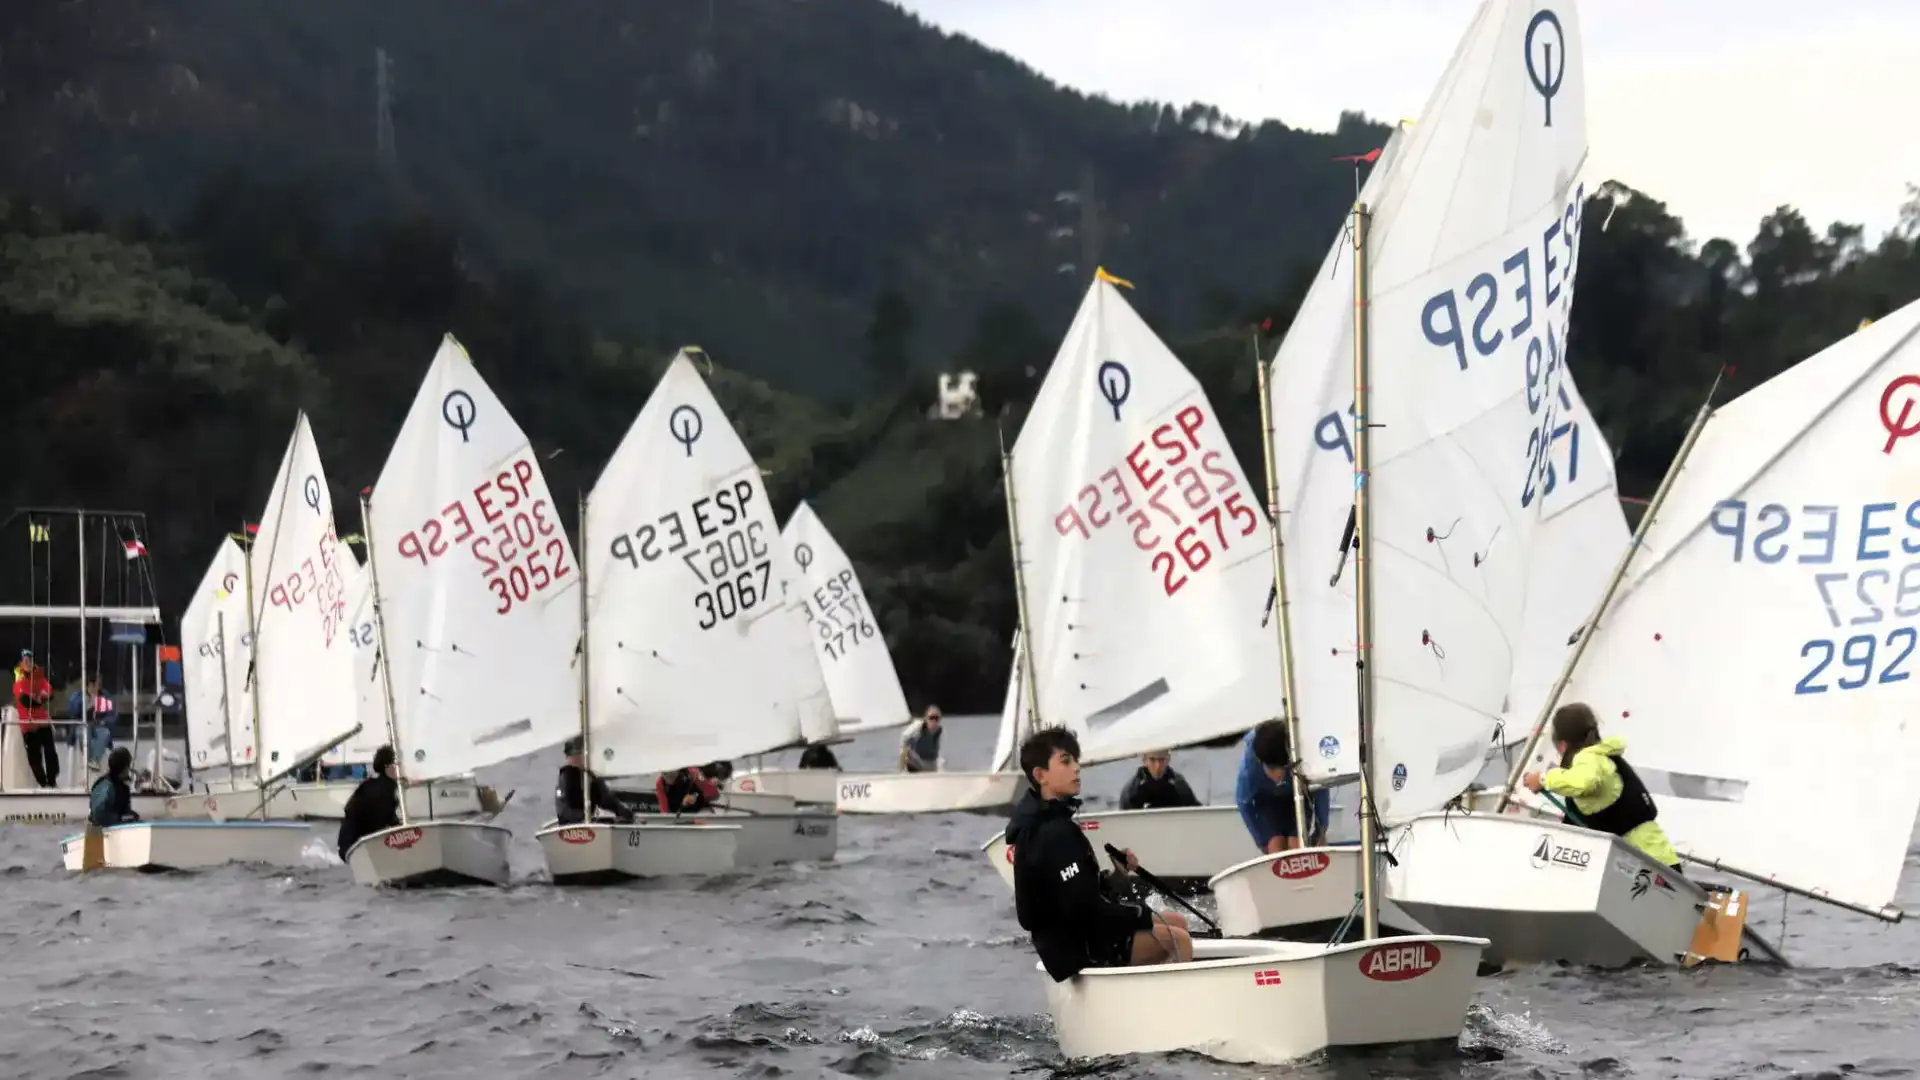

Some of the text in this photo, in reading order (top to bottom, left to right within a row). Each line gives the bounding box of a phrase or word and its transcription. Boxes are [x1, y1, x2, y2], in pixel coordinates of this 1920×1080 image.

[1126, 405, 1205, 491] ESP
[473, 459, 533, 523] ESP
[692, 480, 753, 538] ESP
[1151, 491, 1257, 597] 2675
[488, 538, 570, 615] 3052
[695, 561, 771, 630] 3067
[814, 569, 852, 612] ESP
[824, 616, 874, 661] 1776
[1795, 626, 1918, 695] 292
[841, 783, 872, 799] CVVC
[388, 829, 421, 847] ABRIL
[562, 829, 593, 842] ABRIL
[1552, 845, 1591, 866] ZERO
[1060, 862, 1080, 882] HH
[1279, 853, 1325, 876] ABRIL
[1368, 947, 1433, 975] ABRIL
